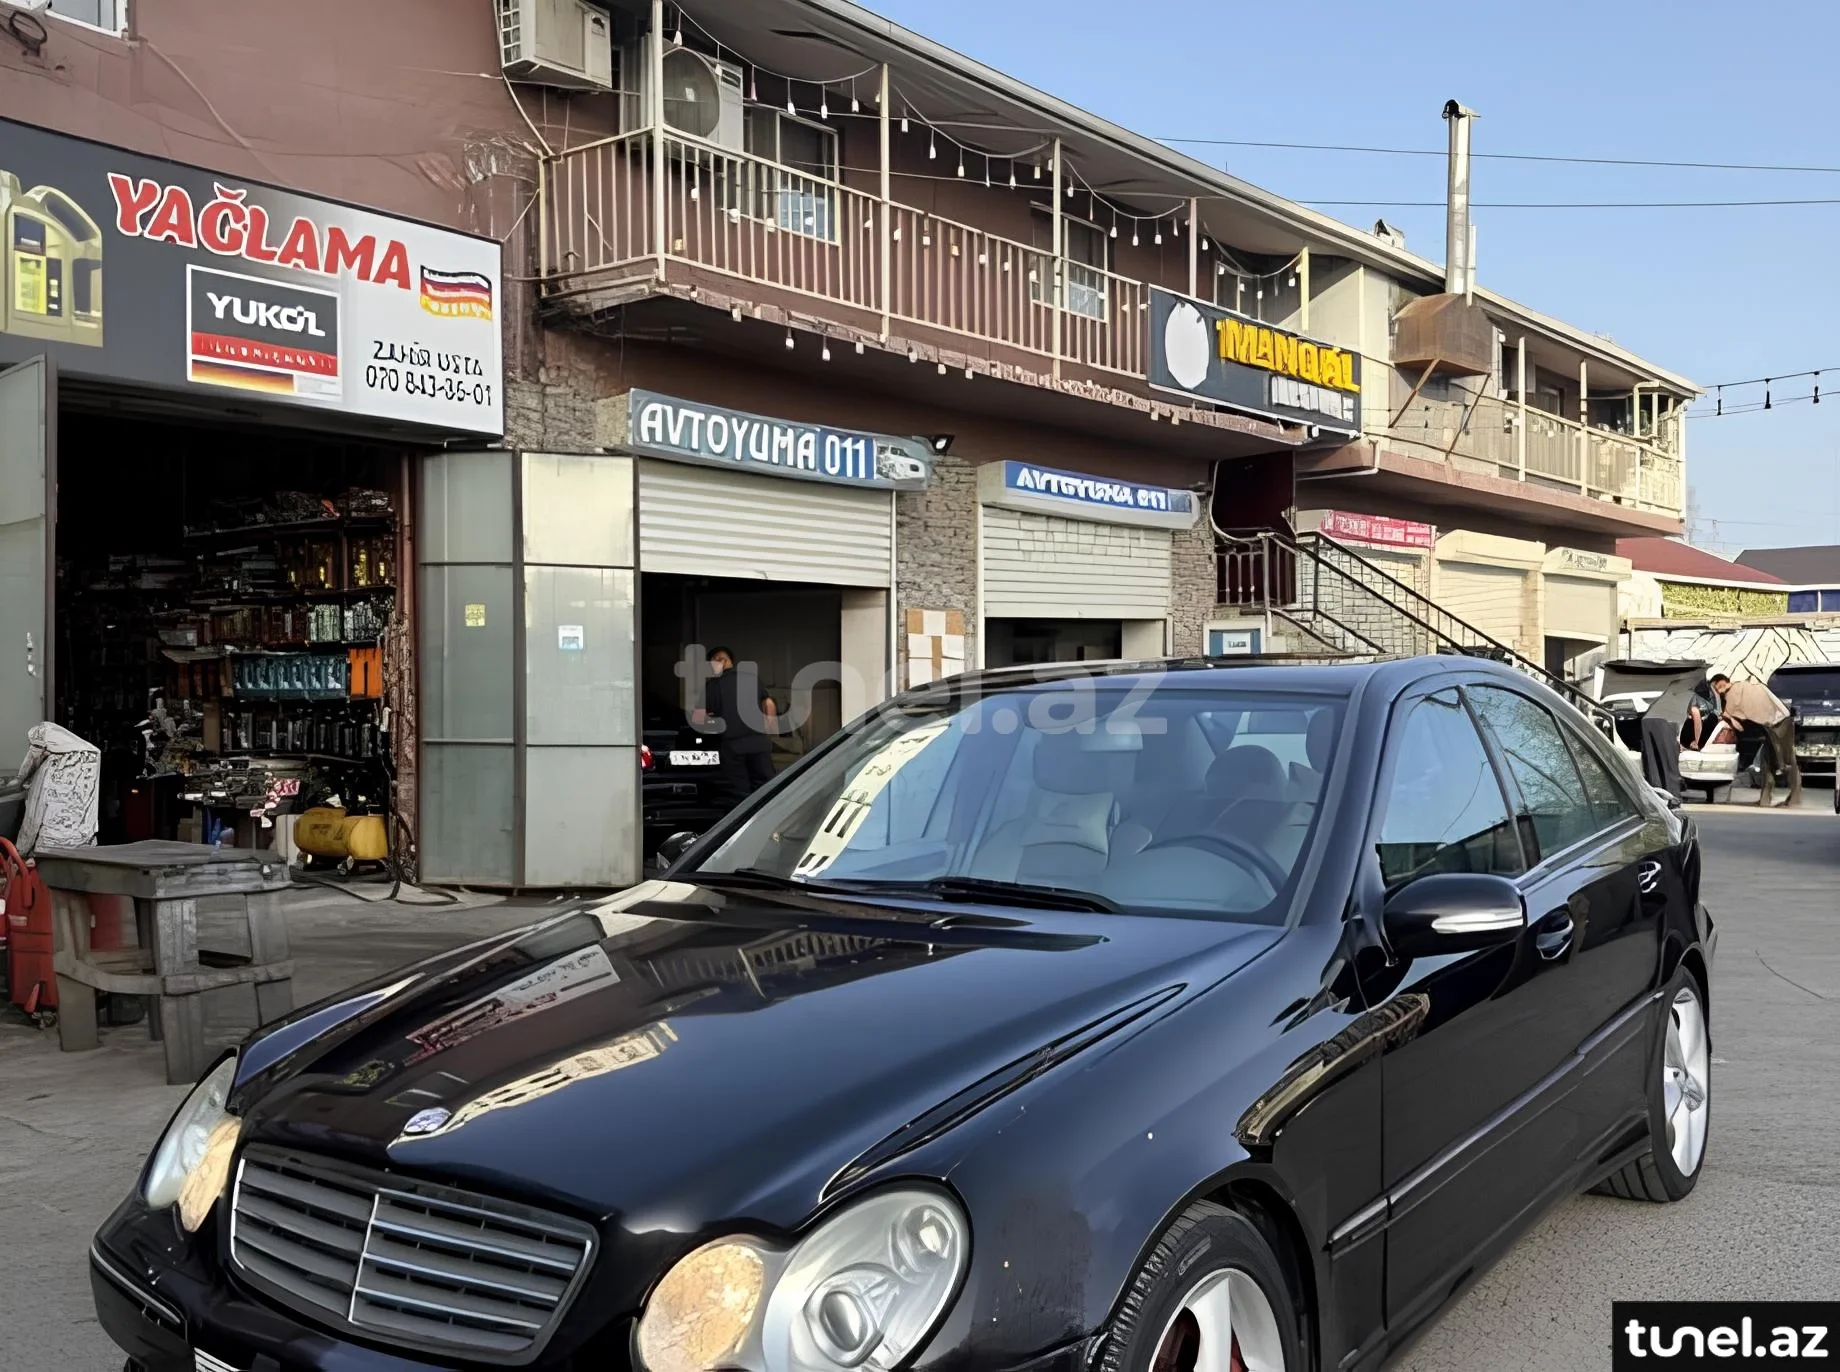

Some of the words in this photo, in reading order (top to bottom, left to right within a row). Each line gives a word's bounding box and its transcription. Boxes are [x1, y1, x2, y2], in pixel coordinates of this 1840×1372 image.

[107, 172, 411, 290] YAĞLAMA
[366, 365, 399, 392] 070
[641, 402, 815, 470] AVTOYUMA
[825, 435, 867, 479] 011
